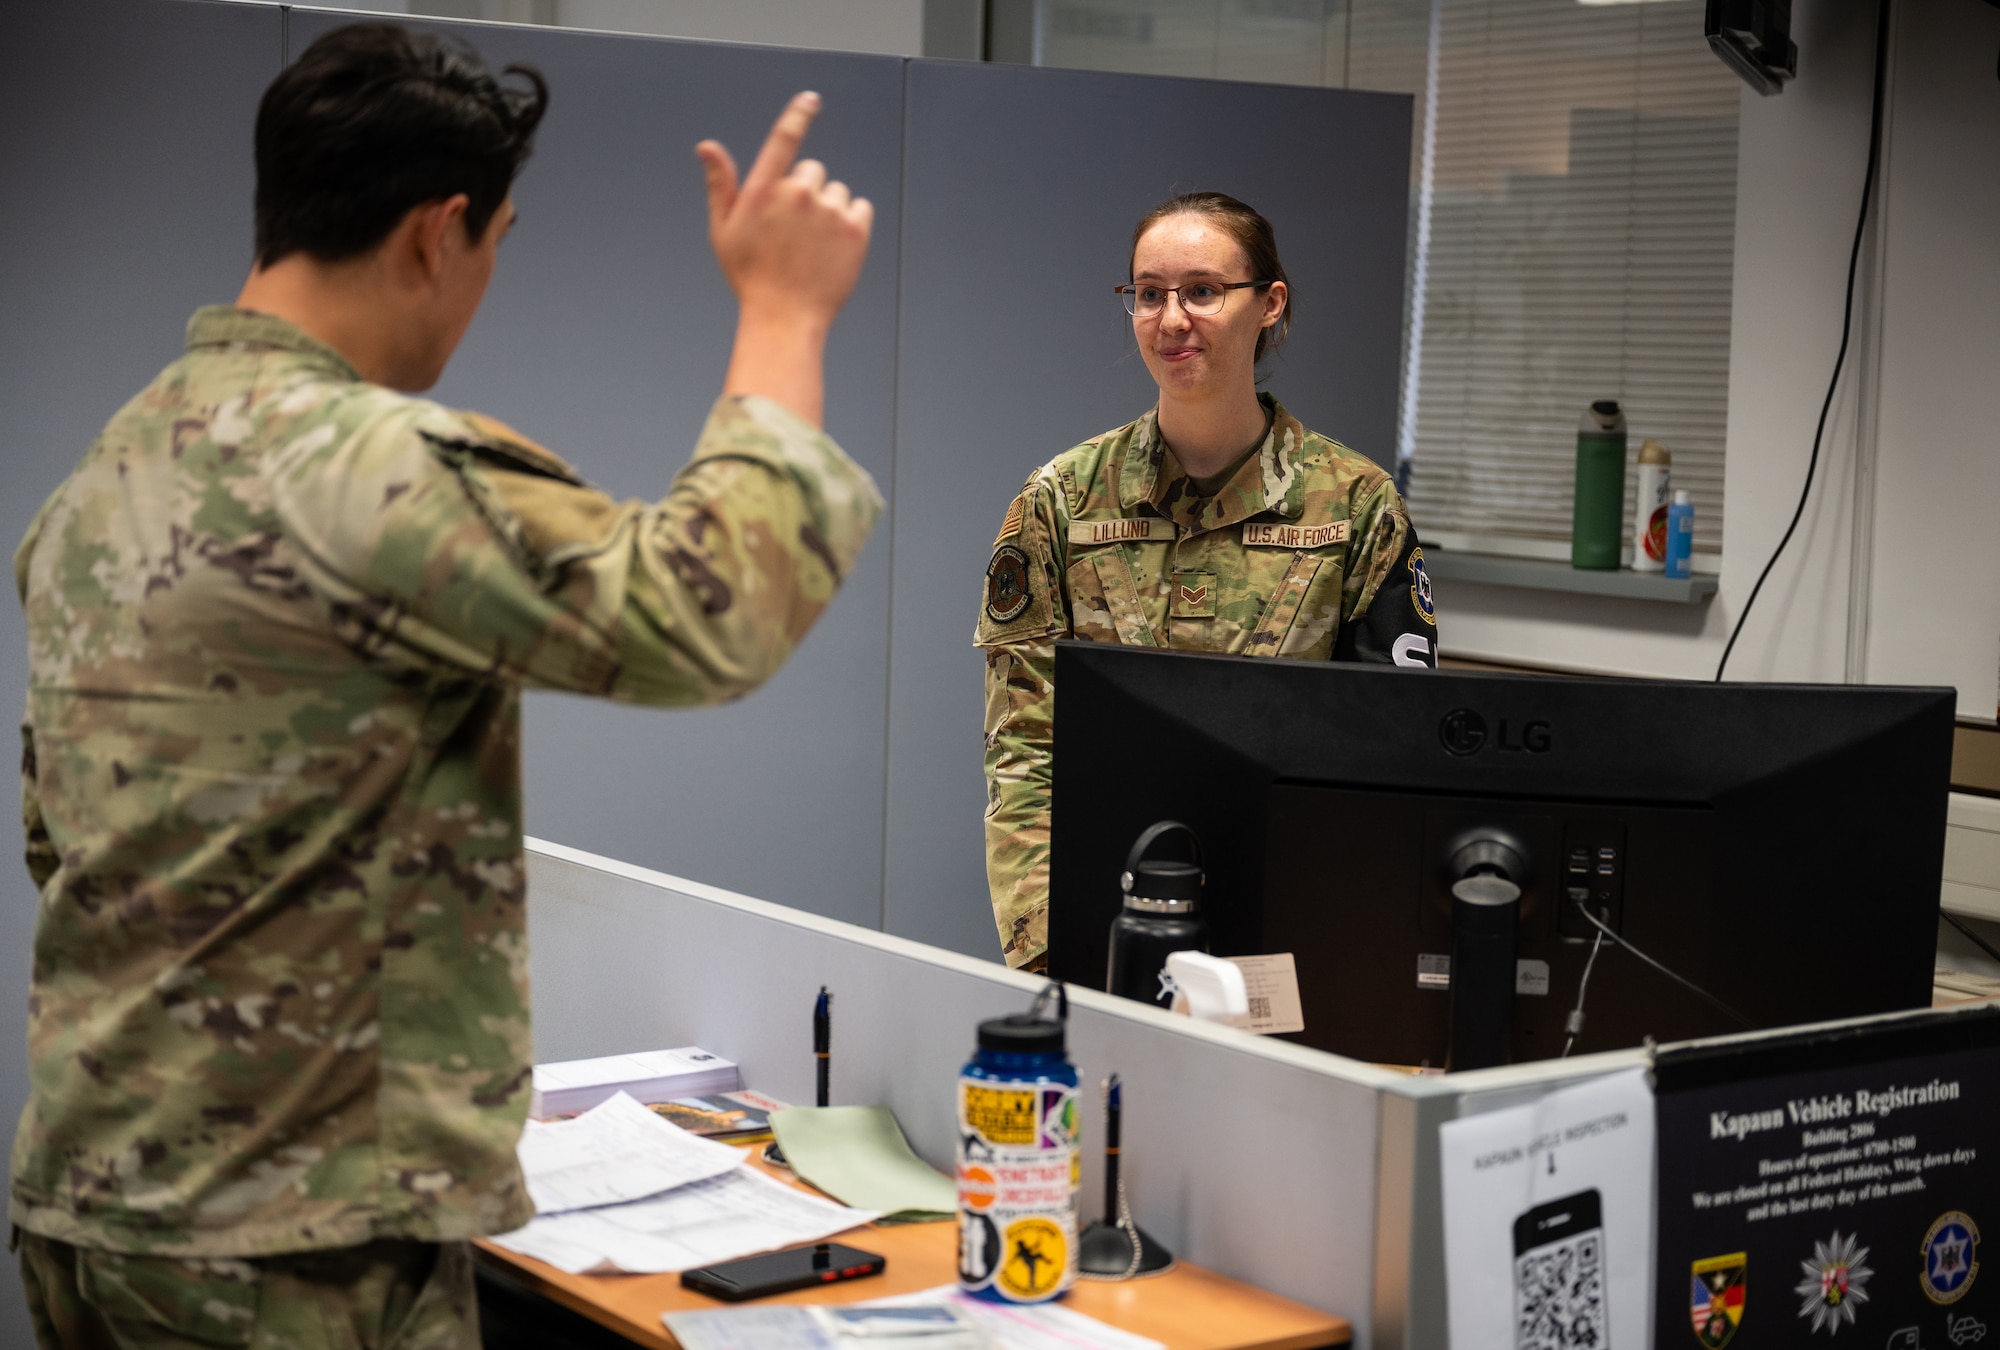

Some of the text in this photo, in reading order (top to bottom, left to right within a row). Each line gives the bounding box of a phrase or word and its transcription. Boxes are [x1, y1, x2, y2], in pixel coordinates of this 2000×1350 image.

[1093, 520, 1150, 543] LILLUND
[1303, 524, 1344, 545] FORCE
[1392, 633, 1438, 668] S
[1498, 719, 1551, 753] LG
[1710, 1079, 1960, 1141] Kapaun Vehicle Registration
[1803, 1127, 1849, 1148] Building
[1693, 1192, 1711, 1209] We
[1714, 1191, 1731, 1206] are
[1733, 1182, 1767, 1202] closed
[1769, 1182, 1783, 1196] on
[1786, 1175, 1800, 1192] all
[1801, 1168, 1842, 1190] Federal
[1893, 1154, 1922, 1174] Wing
[1923, 1150, 1951, 1168] down
[1952, 1148, 1976, 1165] days
[1759, 1157, 1793, 1177] Hours
[1796, 1153, 1807, 1171] of
[1809, 1147, 1862, 1170] operation:
[1746, 1176, 1926, 1222] and the last duty day of the month.
